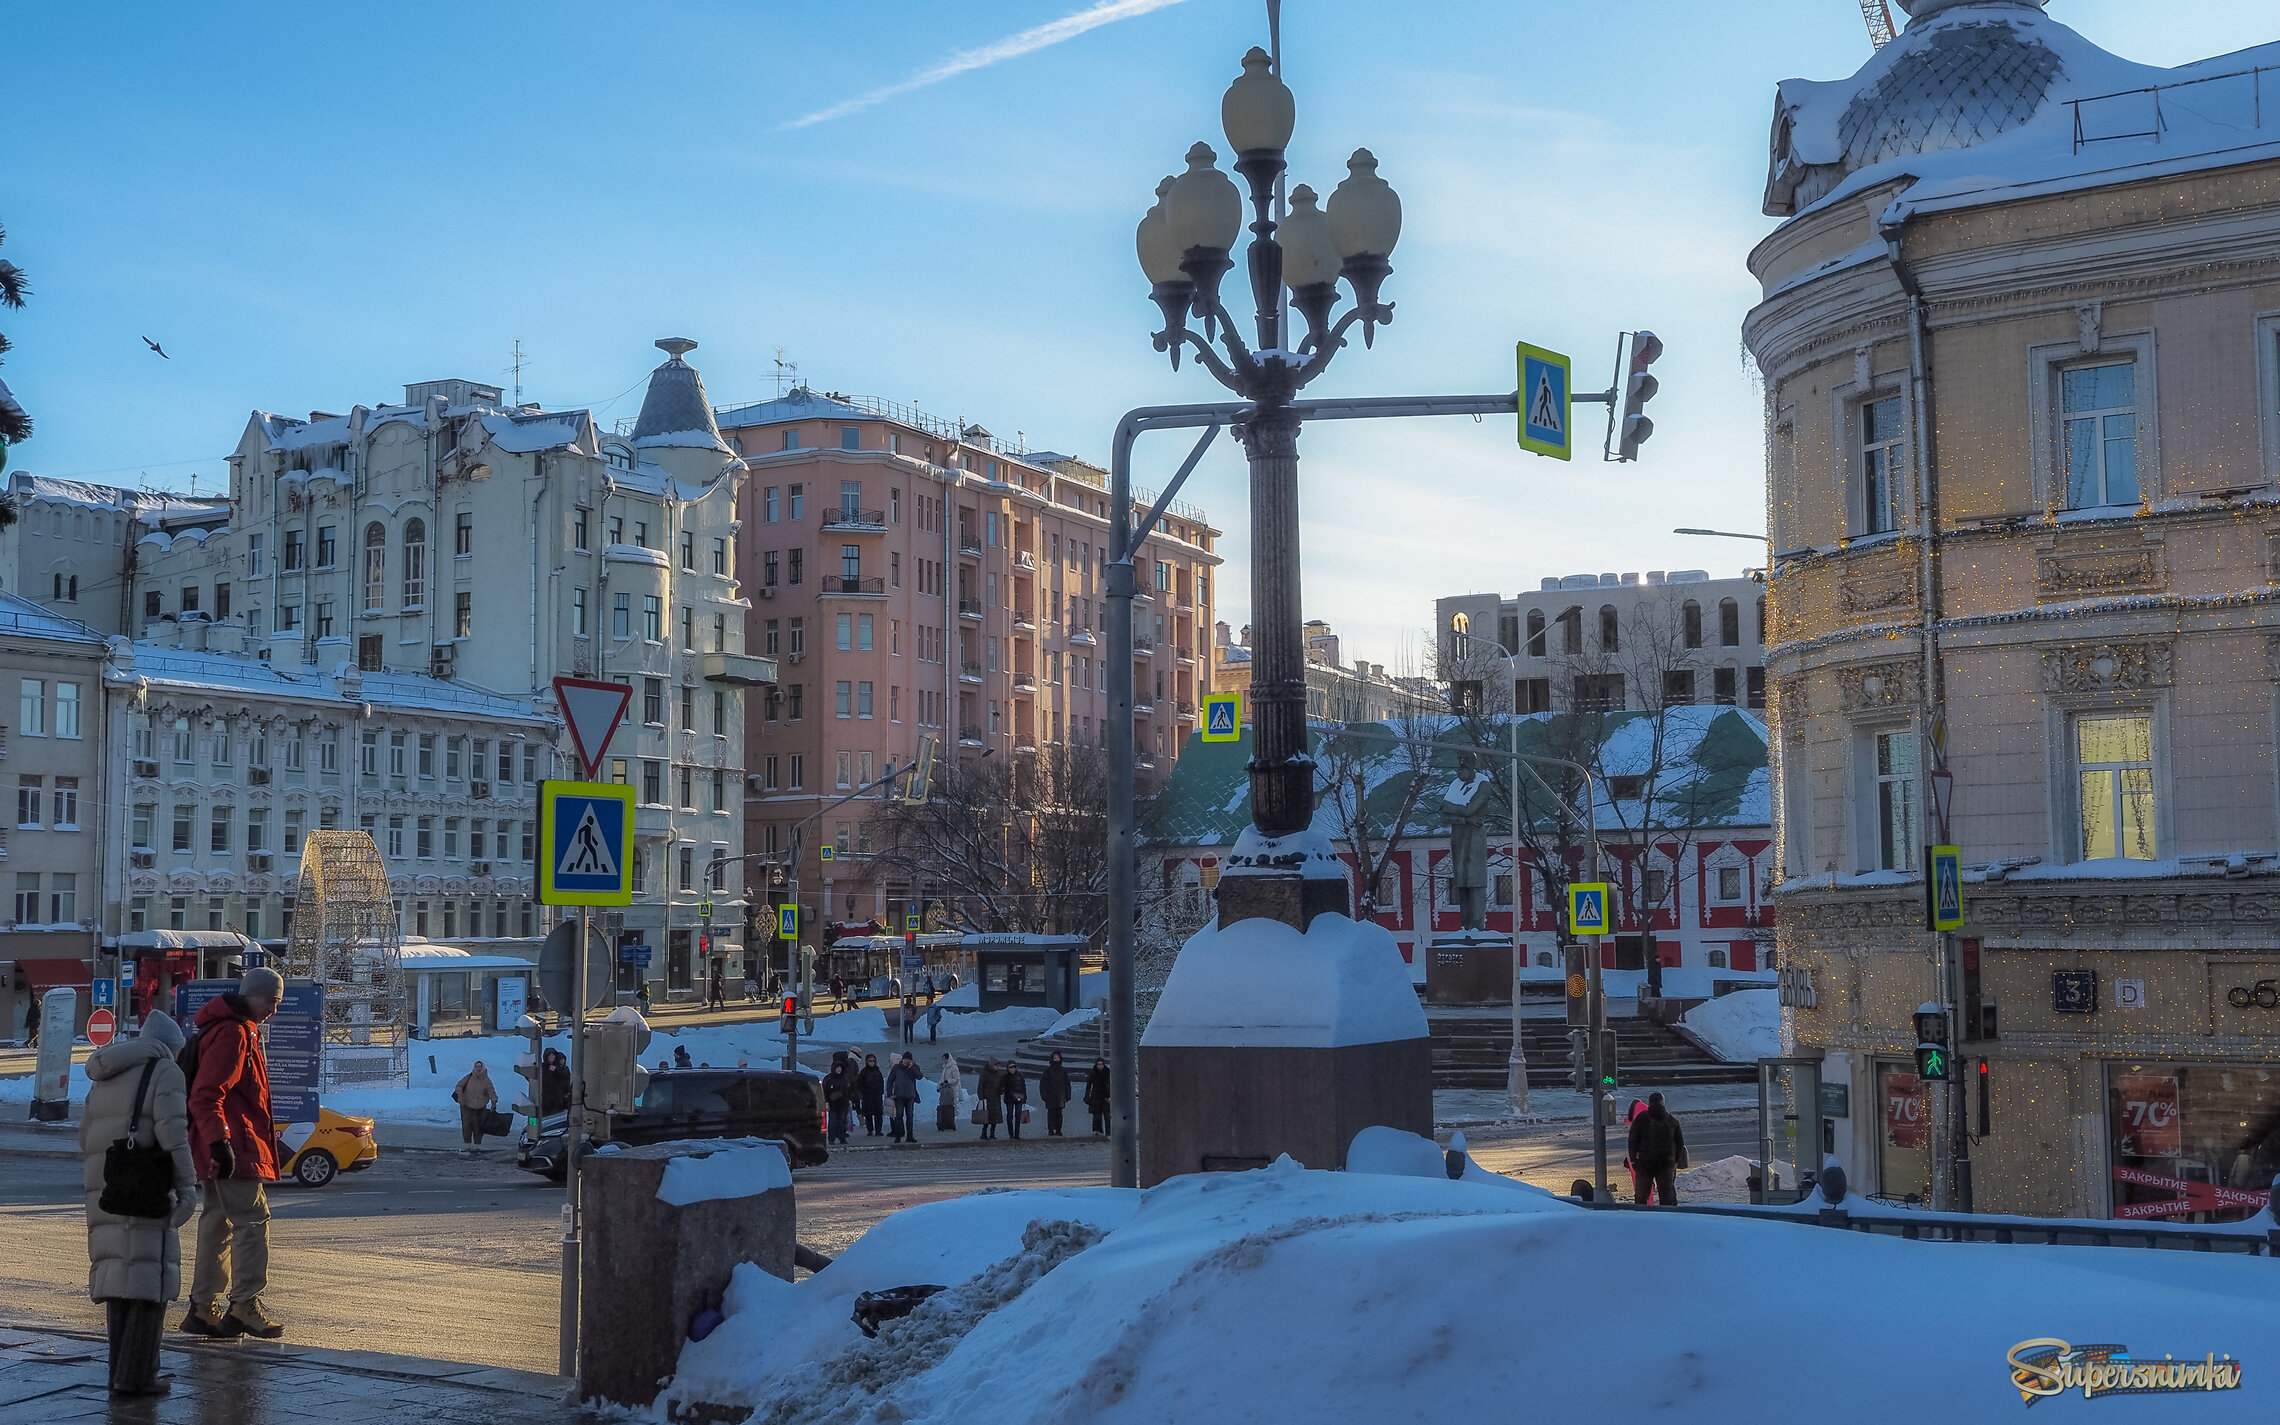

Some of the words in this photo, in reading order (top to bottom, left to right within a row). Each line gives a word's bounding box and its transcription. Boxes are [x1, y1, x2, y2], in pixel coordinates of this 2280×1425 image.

[2066, 981, 2081, 1002] 3
[2122, 985, 2138, 1003] D
[2120, 1170, 2188, 1191] ЗАКРЫТИЕ
[2214, 1188, 2270, 1207] ЗАКРЫТ
[2124, 1201, 2191, 1217] ЗАКРЫТИЕ
